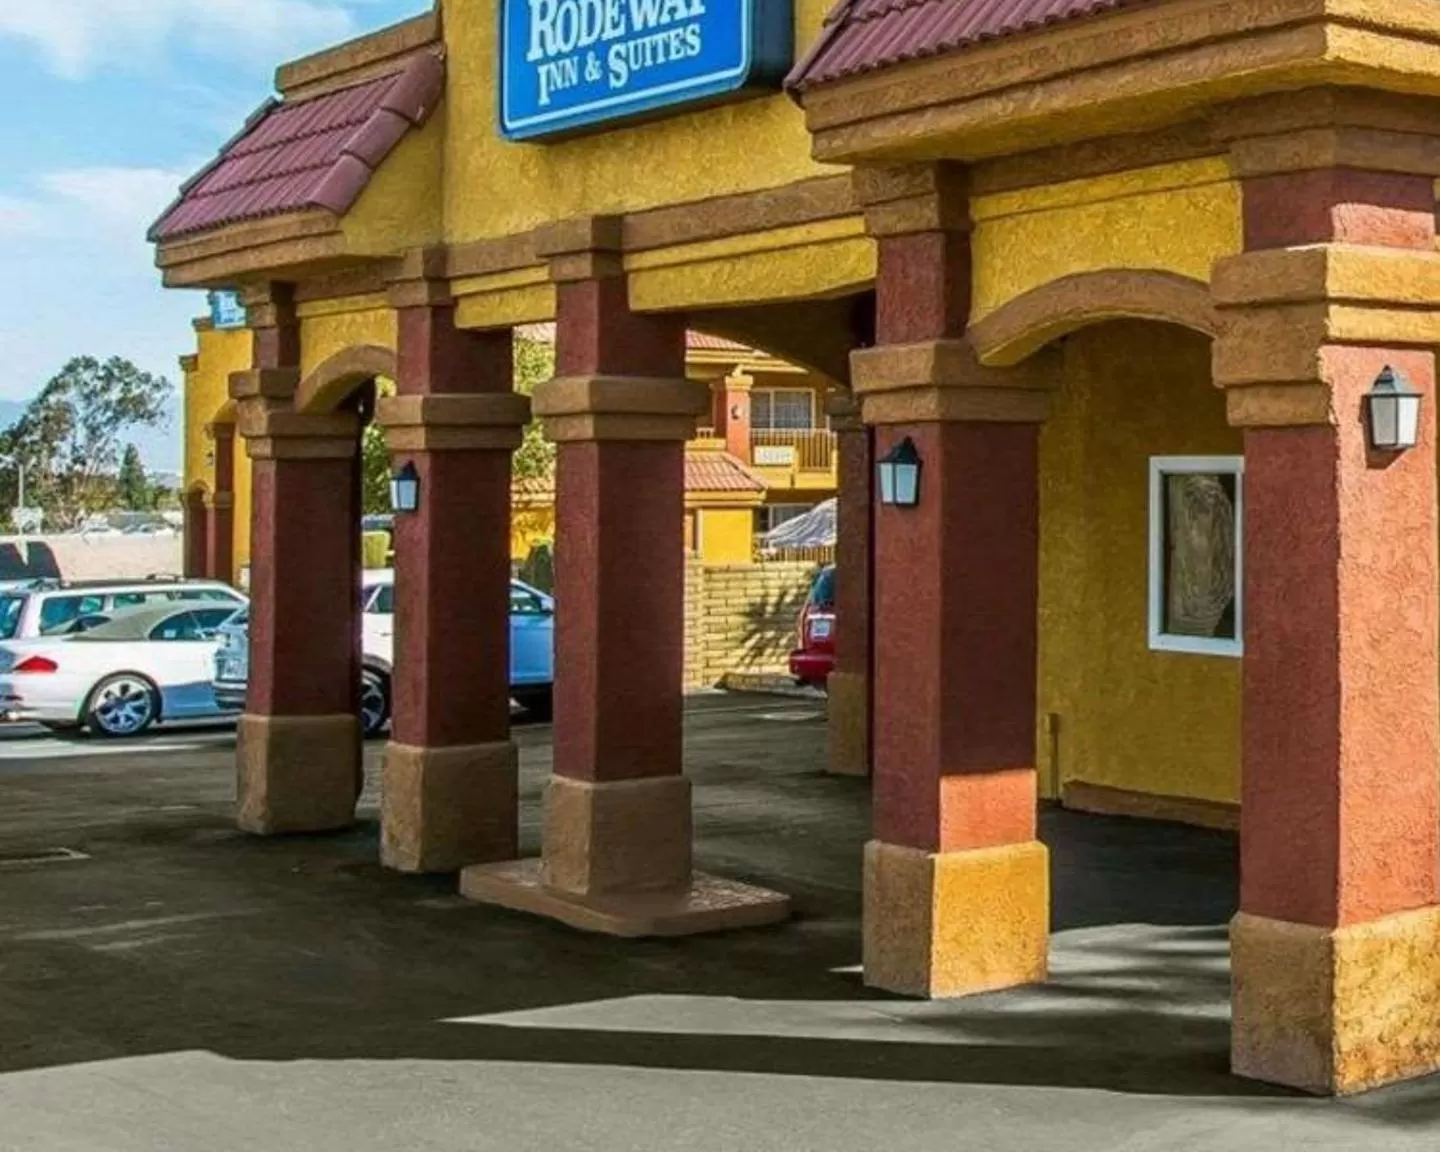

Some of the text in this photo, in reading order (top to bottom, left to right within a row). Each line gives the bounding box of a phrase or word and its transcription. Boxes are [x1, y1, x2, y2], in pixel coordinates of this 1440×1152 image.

[537, 23, 701, 106] INN & SUITES
